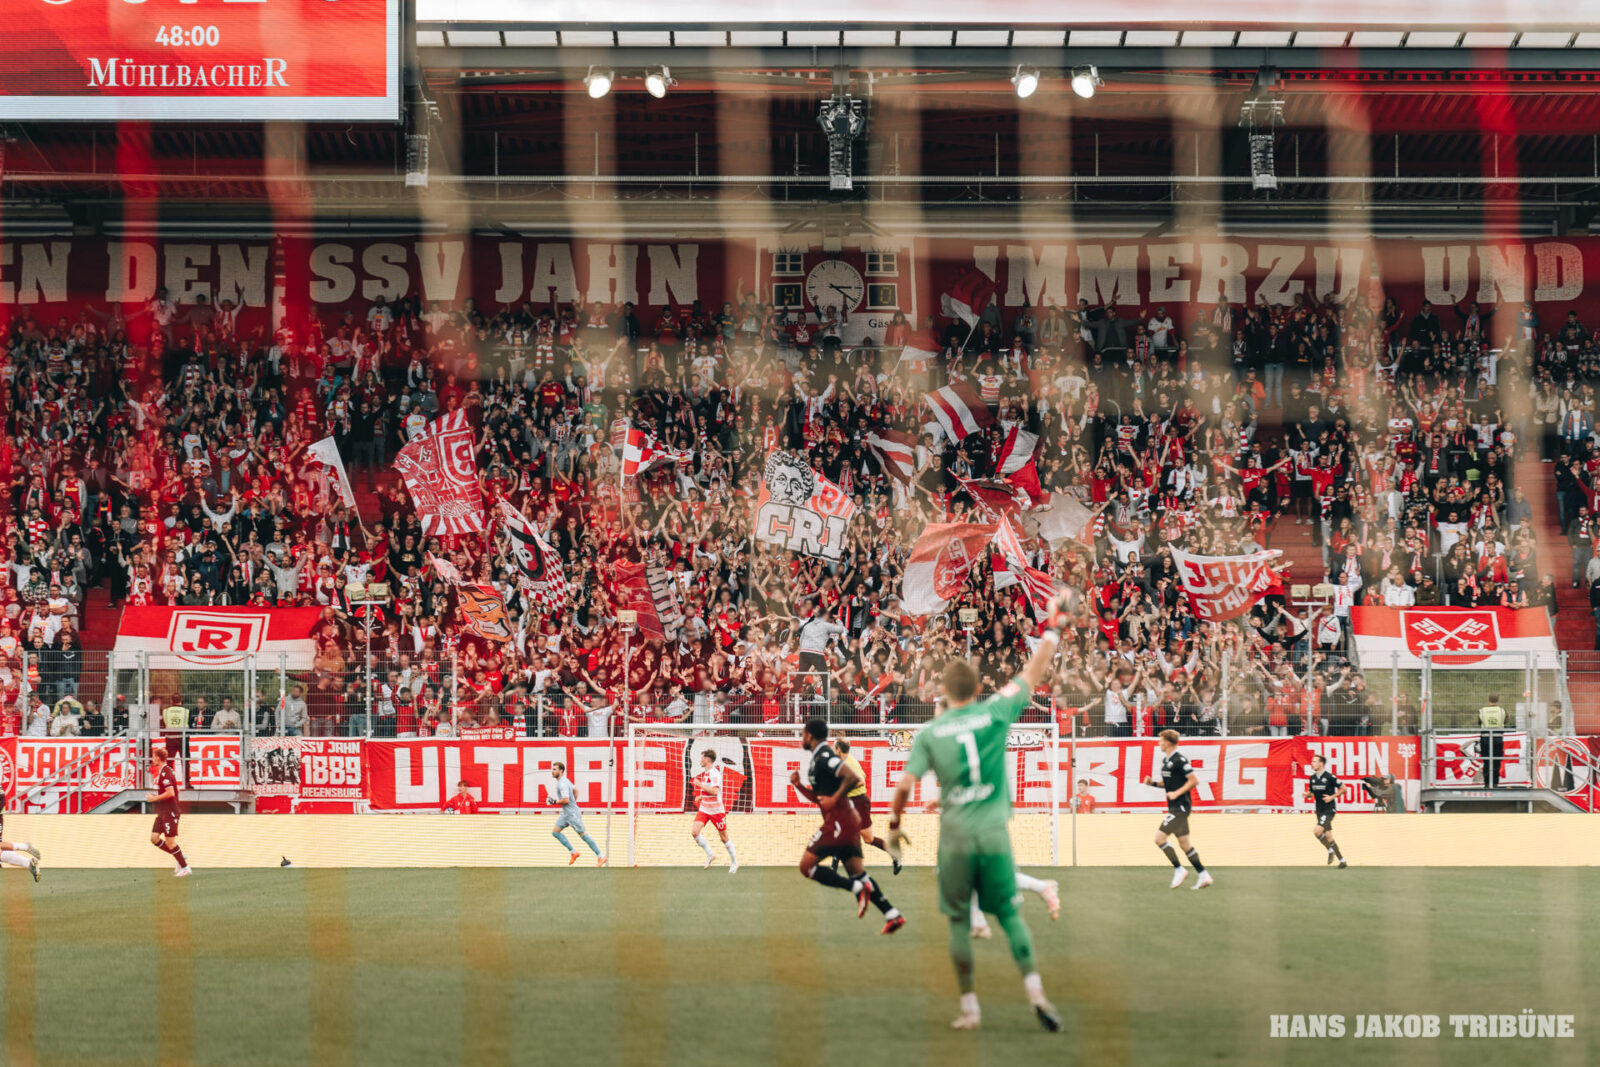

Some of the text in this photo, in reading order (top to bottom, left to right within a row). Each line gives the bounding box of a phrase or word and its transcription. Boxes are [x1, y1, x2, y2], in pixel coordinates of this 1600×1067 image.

[155, 25, 219, 46] 48:00
[87, 58, 289, 87] MÜHLBACHER
[105, 241, 269, 307] DEN
[309, 242, 465, 303] SSV
[496, 242, 699, 306] JAHN
[1421, 243, 1584, 305] UND
[756, 502, 847, 560] CRI
[301, 741, 324, 753] SSV
[328, 741, 361, 754] JAHN
[956, 731, 982, 787] 1
[301, 755, 362, 785] 1889
[395, 746, 667, 803] ULTRAS
[302, 787, 362, 798] REGENSBURG
